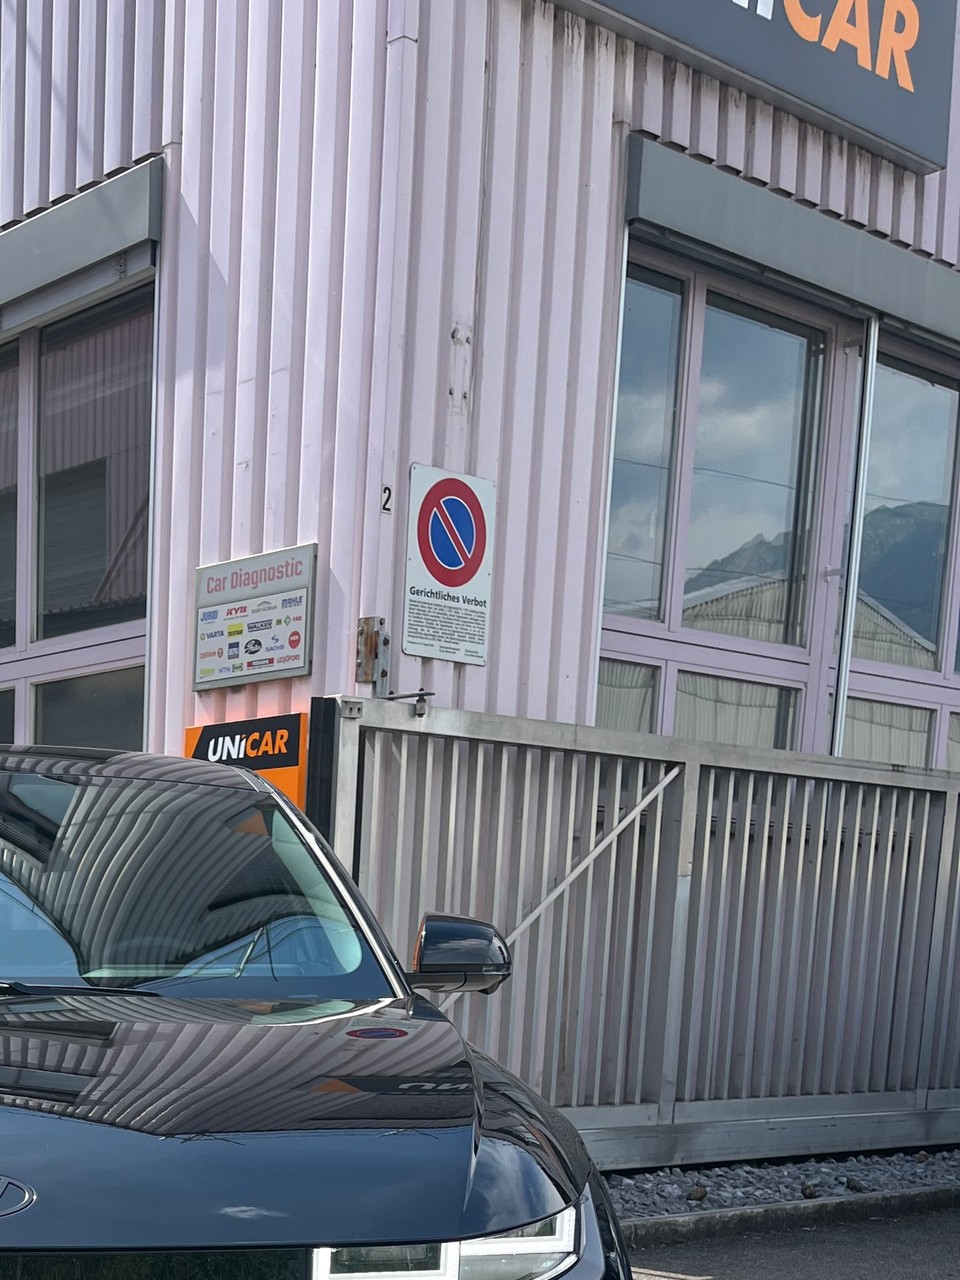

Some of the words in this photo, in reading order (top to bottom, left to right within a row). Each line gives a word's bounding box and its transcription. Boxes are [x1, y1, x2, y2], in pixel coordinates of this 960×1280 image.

[382, 486, 391, 512] 2
[207, 576, 228, 594] Car
[230, 557, 304, 590] Diagnostic
[281, 596, 304, 606] MAHLE
[409, 586, 460, 603] Gerichtliches
[461, 595, 487, 608] Verbot
[206, 630, 225, 639] VARTA
